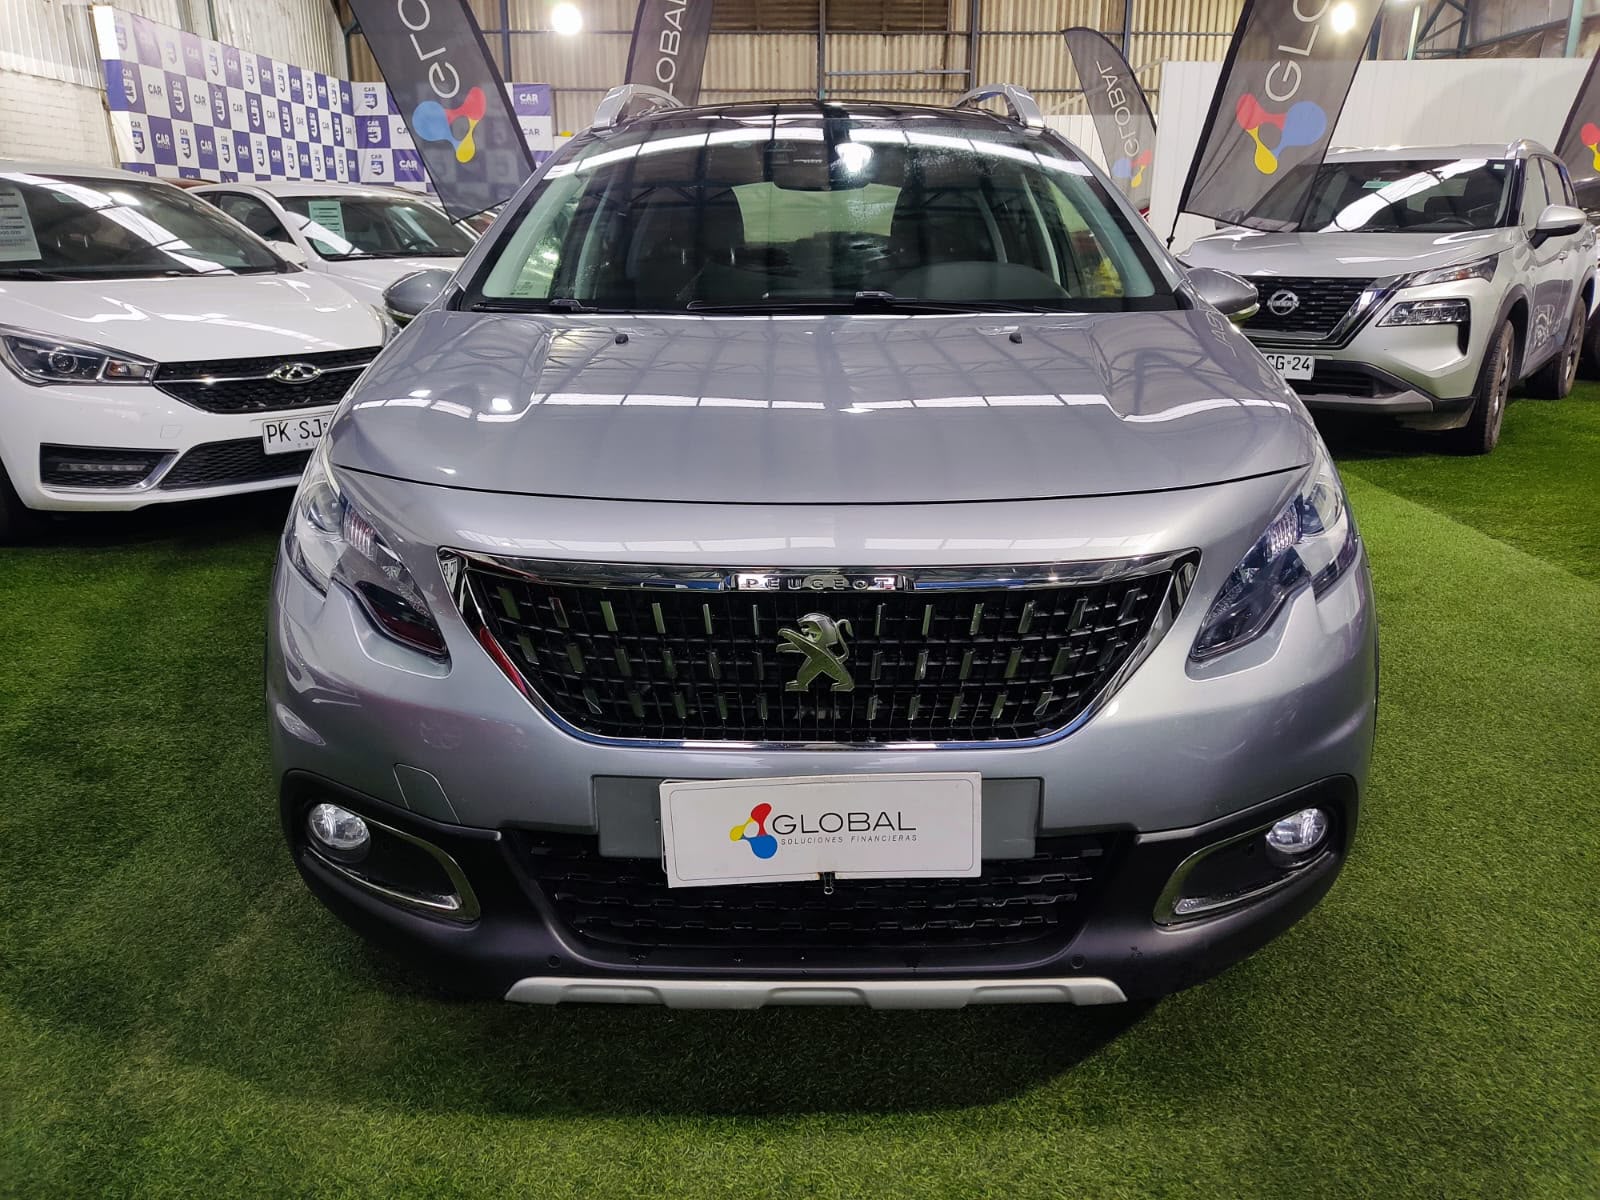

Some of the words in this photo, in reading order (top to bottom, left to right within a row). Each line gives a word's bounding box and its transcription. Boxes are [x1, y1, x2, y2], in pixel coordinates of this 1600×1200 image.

[148, 84, 163, 97] CAR
[193, 93, 207, 106] CAR
[519, 93, 538, 102] CAR
[232, 103, 244, 114] CAR
[131, 120, 142, 128] CAR
[155, 132, 170, 146] CAR
[200, 139, 213, 152] CAR
[237, 145, 249, 156] CAR
[399, 160, 418, 169] CAR
[745, 578, 889, 590] PEUGEOT
[772, 811, 917, 835] GLOBAL
[781, 836, 844, 846] SOLUCIONES
[850, 834, 918, 844] FINANCIERAS
